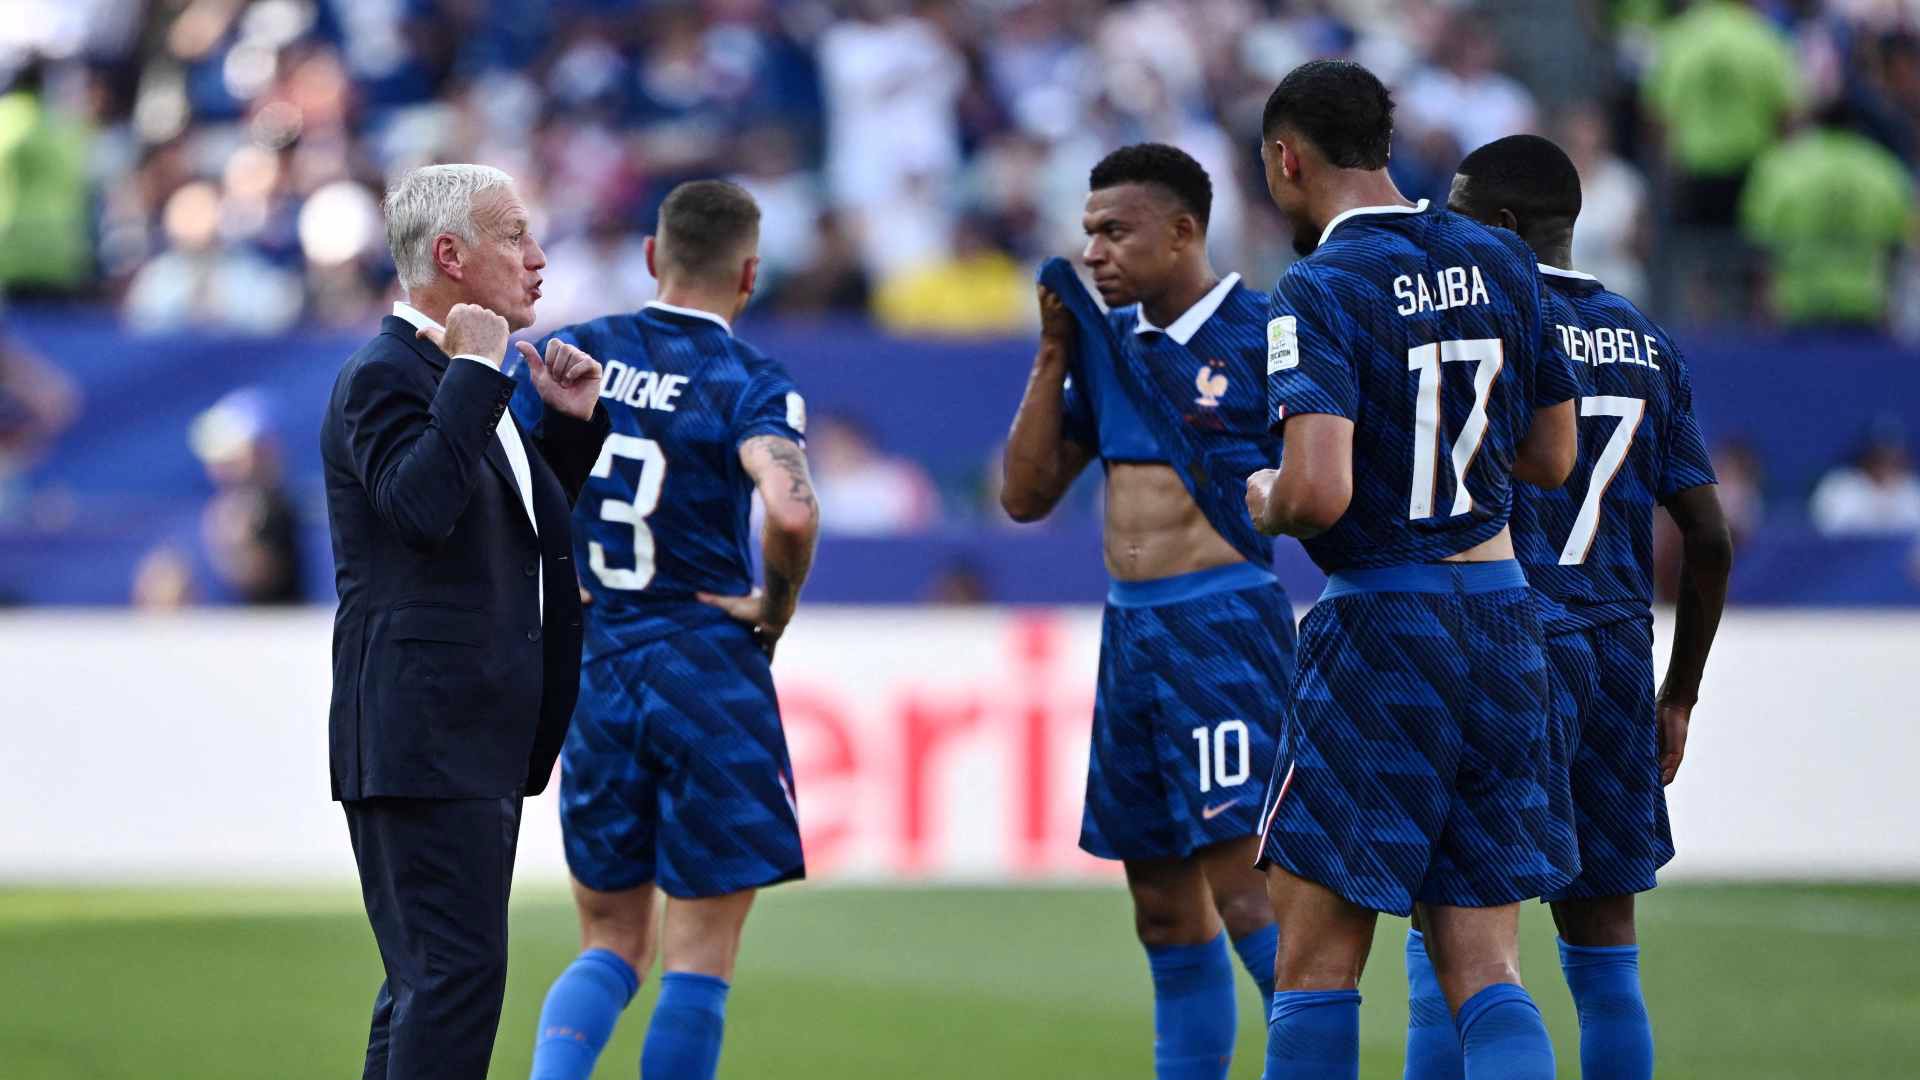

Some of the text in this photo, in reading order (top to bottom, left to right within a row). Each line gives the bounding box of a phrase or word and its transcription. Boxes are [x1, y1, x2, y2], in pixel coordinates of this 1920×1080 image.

[599, 359, 689, 412] DIGNE
[1408, 338, 1503, 520] 17
[588, 432, 666, 591] 3
[1558, 396, 1646, 566] 7
[1192, 719, 1250, 793] 10
